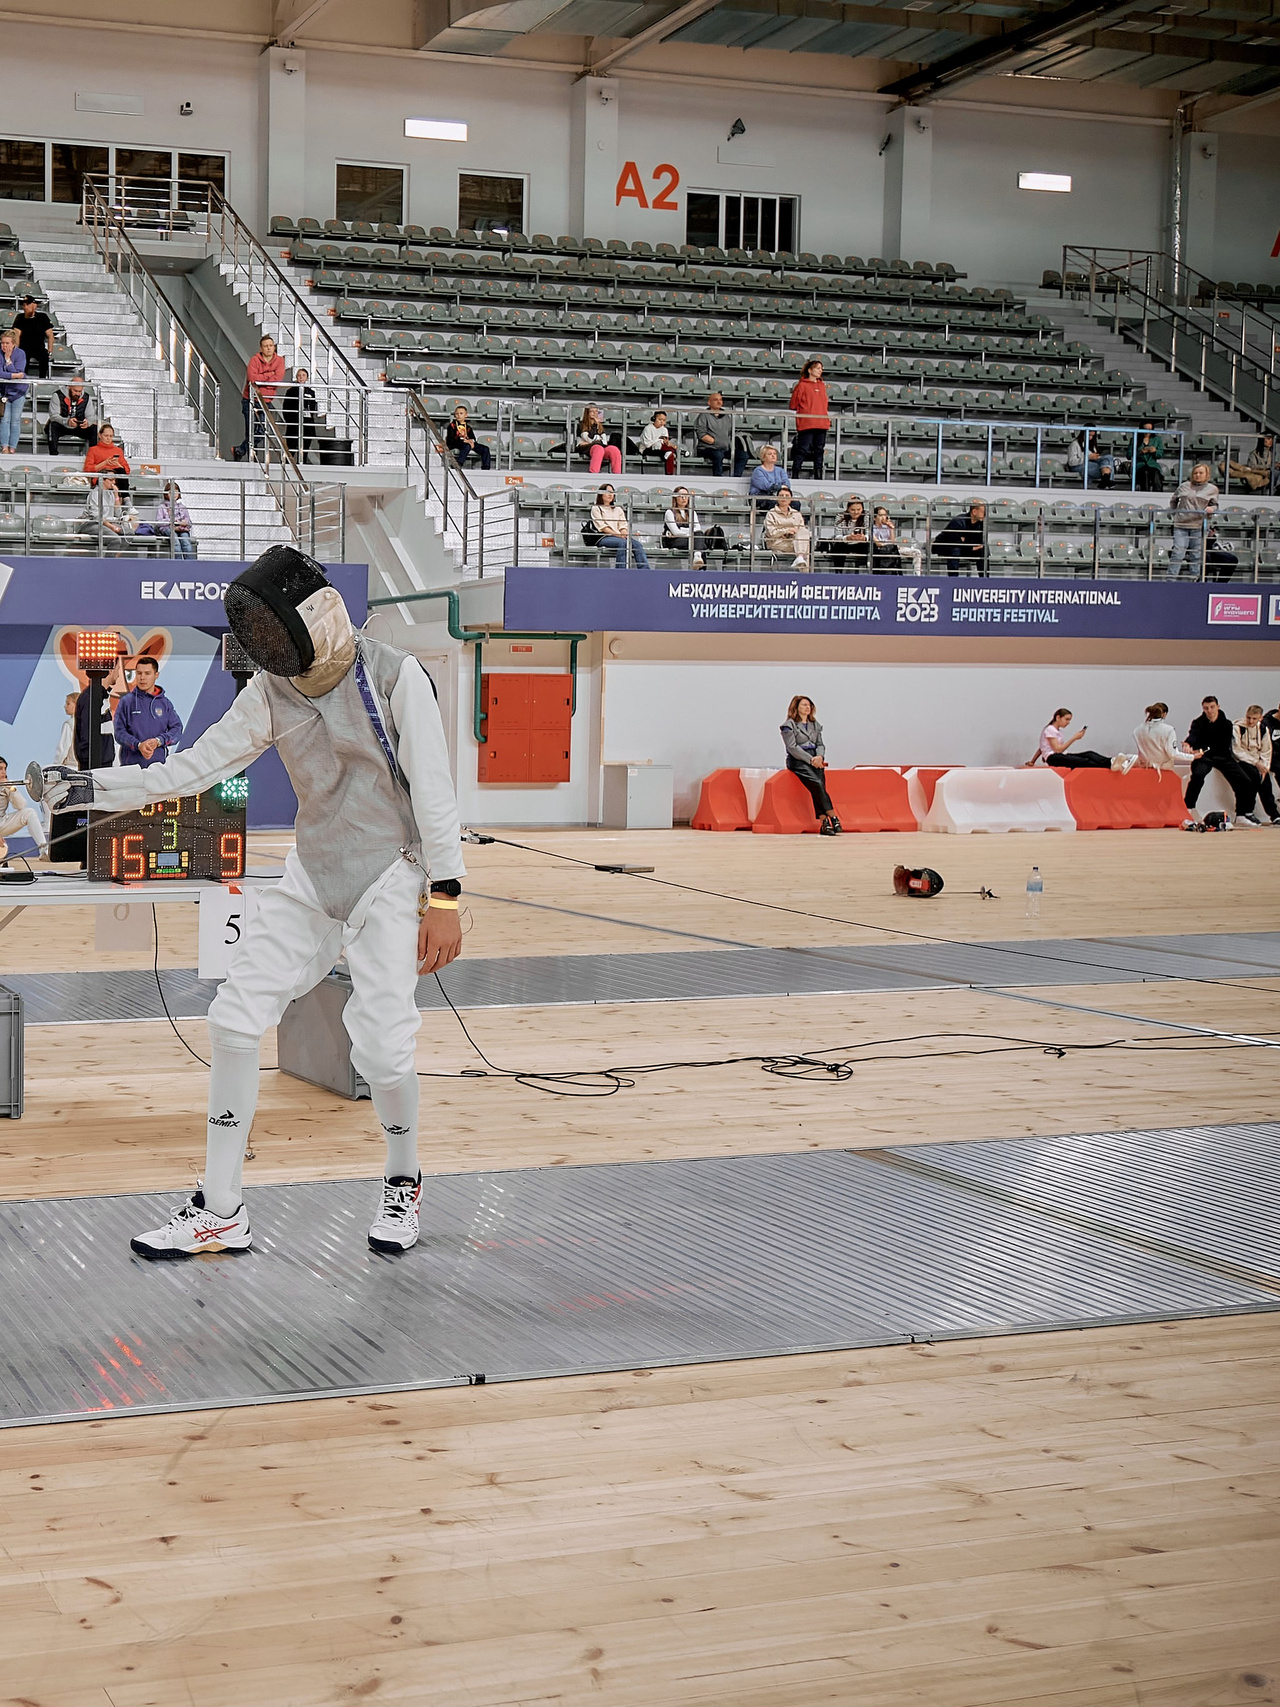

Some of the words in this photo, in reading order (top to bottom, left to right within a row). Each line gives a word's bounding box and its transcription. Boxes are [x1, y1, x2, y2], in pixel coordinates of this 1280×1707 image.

[616, 161, 680, 211] A2
[141, 581, 230, 600] EKAT202
[669, 580, 798, 600] МЕЖДУНАРОДНЫЙ
[801, 584, 881, 601] ФЕСТИВАЛЬ
[897, 587, 940, 604] EKAT
[953, 588, 1026, 604] UNIVERSITY
[1027, 589, 1121, 605] INTERNATIONAL
[690, 603, 828, 619] УНИВЕРСИТЕТСКОГО
[830, 606, 881, 620] СПОРТА
[896, 603, 939, 622] 2023
[951, 607, 1001, 622] SPORTS
[1003, 608, 1059, 623] FESTIVAL
[162, 818, 178, 850] 3
[111, 834, 146, 880] 15
[220, 833, 243, 877] 9
[224, 914, 241, 945] 5
[208, 1116, 241, 1128] DEMIX
